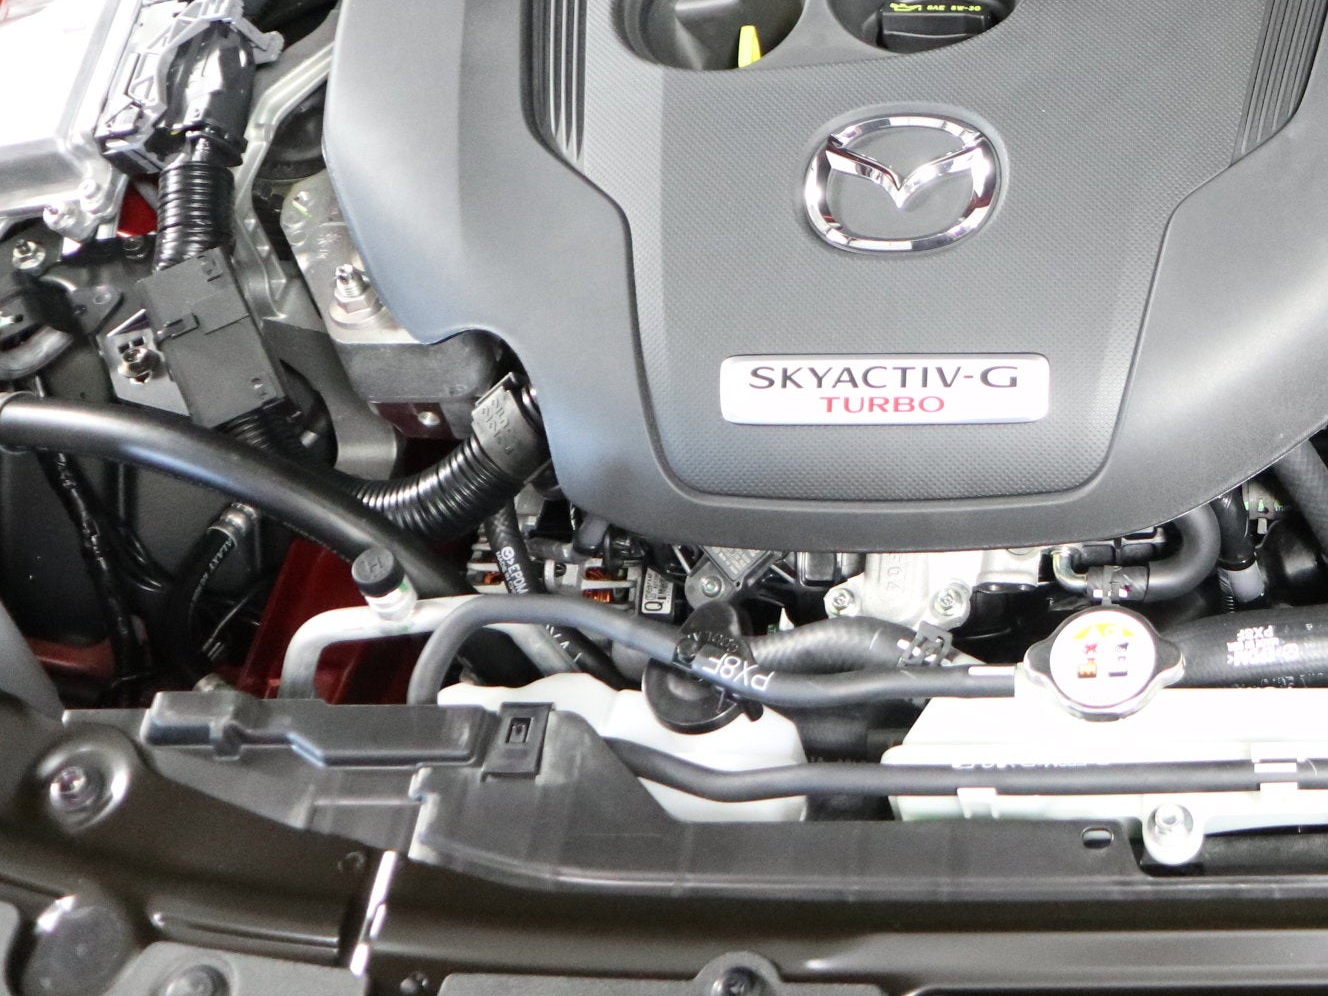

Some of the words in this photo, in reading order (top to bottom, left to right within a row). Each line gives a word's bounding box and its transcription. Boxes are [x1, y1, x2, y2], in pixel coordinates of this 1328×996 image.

[927, 4, 946, 12] SAE
[748, 366, 1018, 389] SKYACTIV-G
[819, 395, 945, 414] TURBO
[701, 653, 775, 692] PX8F
